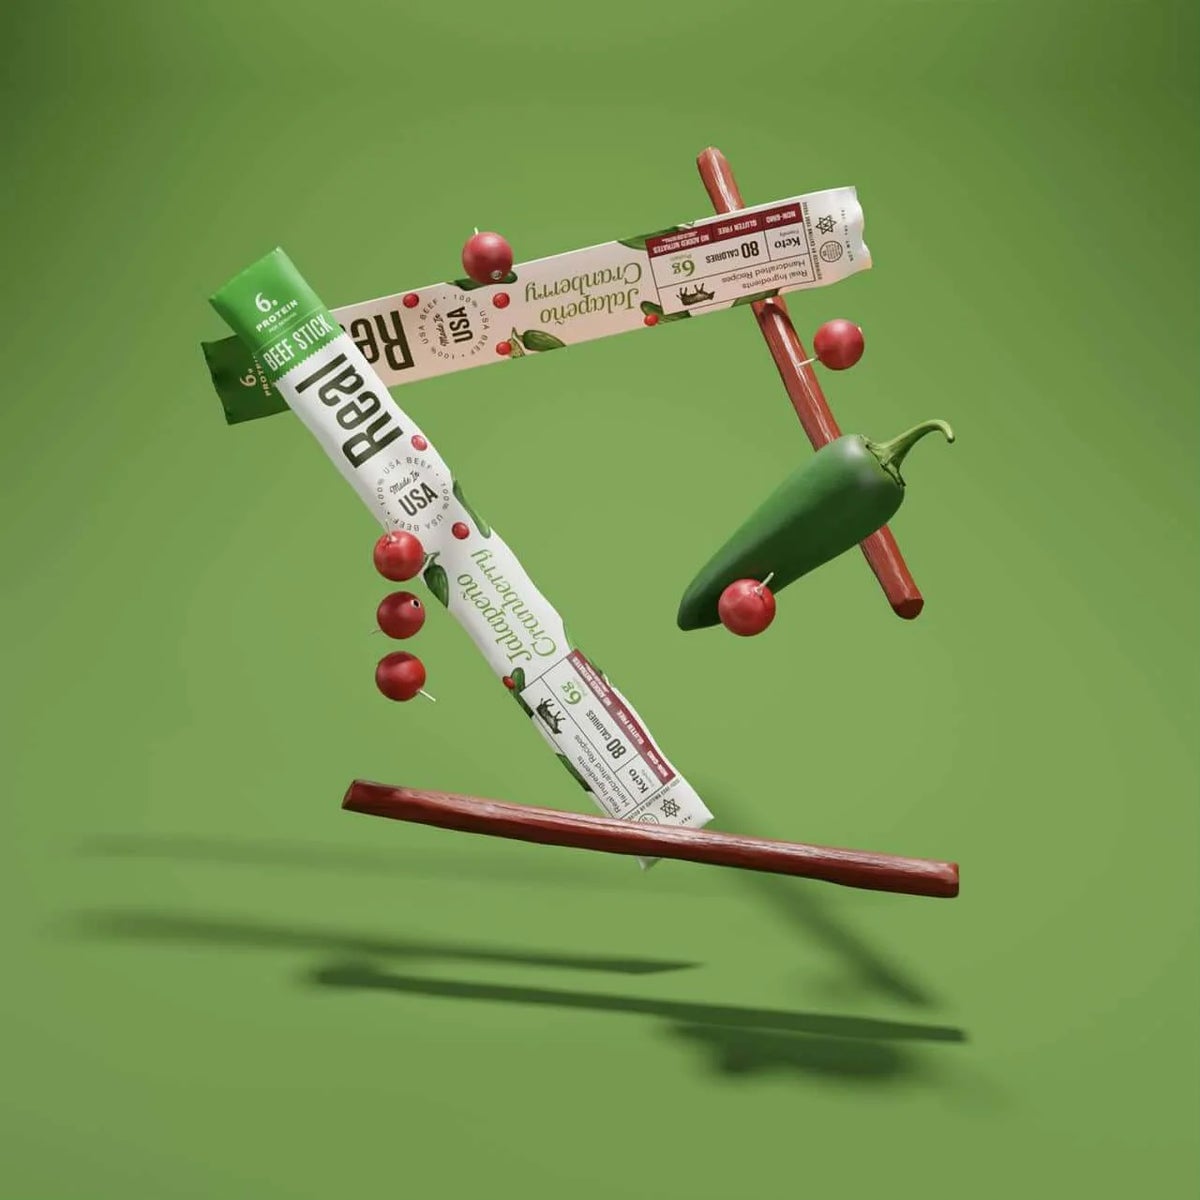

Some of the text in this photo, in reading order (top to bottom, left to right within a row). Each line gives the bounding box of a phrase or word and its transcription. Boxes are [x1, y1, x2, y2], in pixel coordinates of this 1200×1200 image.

[704, 240, 760, 264] 80 CALORIES
[773, 235, 801, 249] Keto
[524, 261, 643, 303] Cranberry
[670, 259, 696, 277] 6g
[720, 258, 805, 283] Handcrafted Recipes
[741, 268, 807, 289] Real Ingredients
[255, 298, 298, 332] PROTEIN
[445, 305, 474, 344] USA
[539, 287, 642, 326] Jalapeño
[262, 312, 334, 371] BEEF STICK
[338, 309, 415, 371] Re
[252, 354, 271, 397] PROTE
[293, 352, 404, 469] Real
[397, 481, 439, 517] USA
[457, 573, 533, 663] Jalapeño
[469, 548, 557, 657] Cranberry
[561, 680, 582, 706] 6g
[585, 709, 612, 741] CALORIES
[605, 737, 627, 760] 80
[573, 733, 631, 808] Handcrafted Recipes
[576, 755, 622, 814] Real Ingredients
[628, 768, 649, 794] Keto
